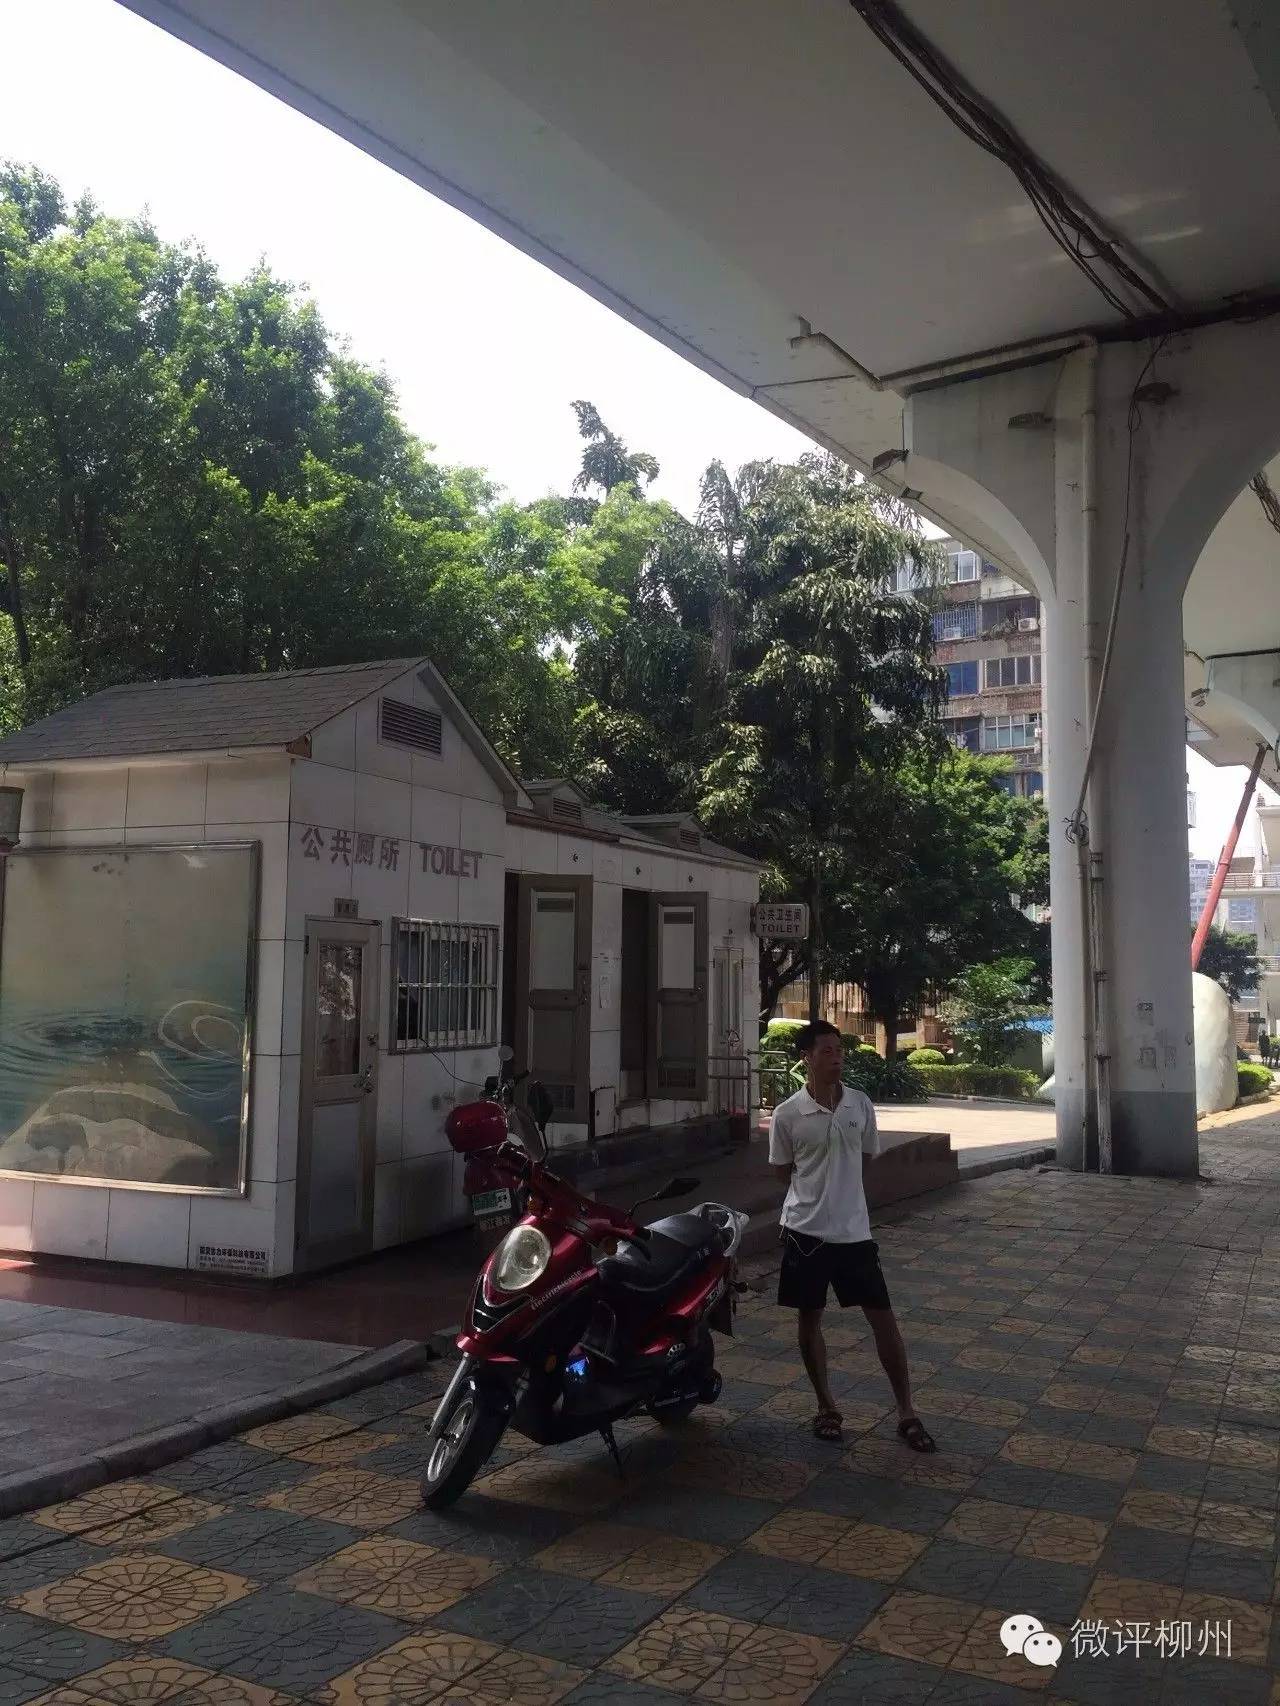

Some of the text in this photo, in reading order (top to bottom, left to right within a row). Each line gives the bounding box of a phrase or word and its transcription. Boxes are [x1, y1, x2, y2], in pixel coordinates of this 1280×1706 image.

[301, 827, 482, 879] 公共厕所 TOILET
[760, 923, 800, 934] TOILET
